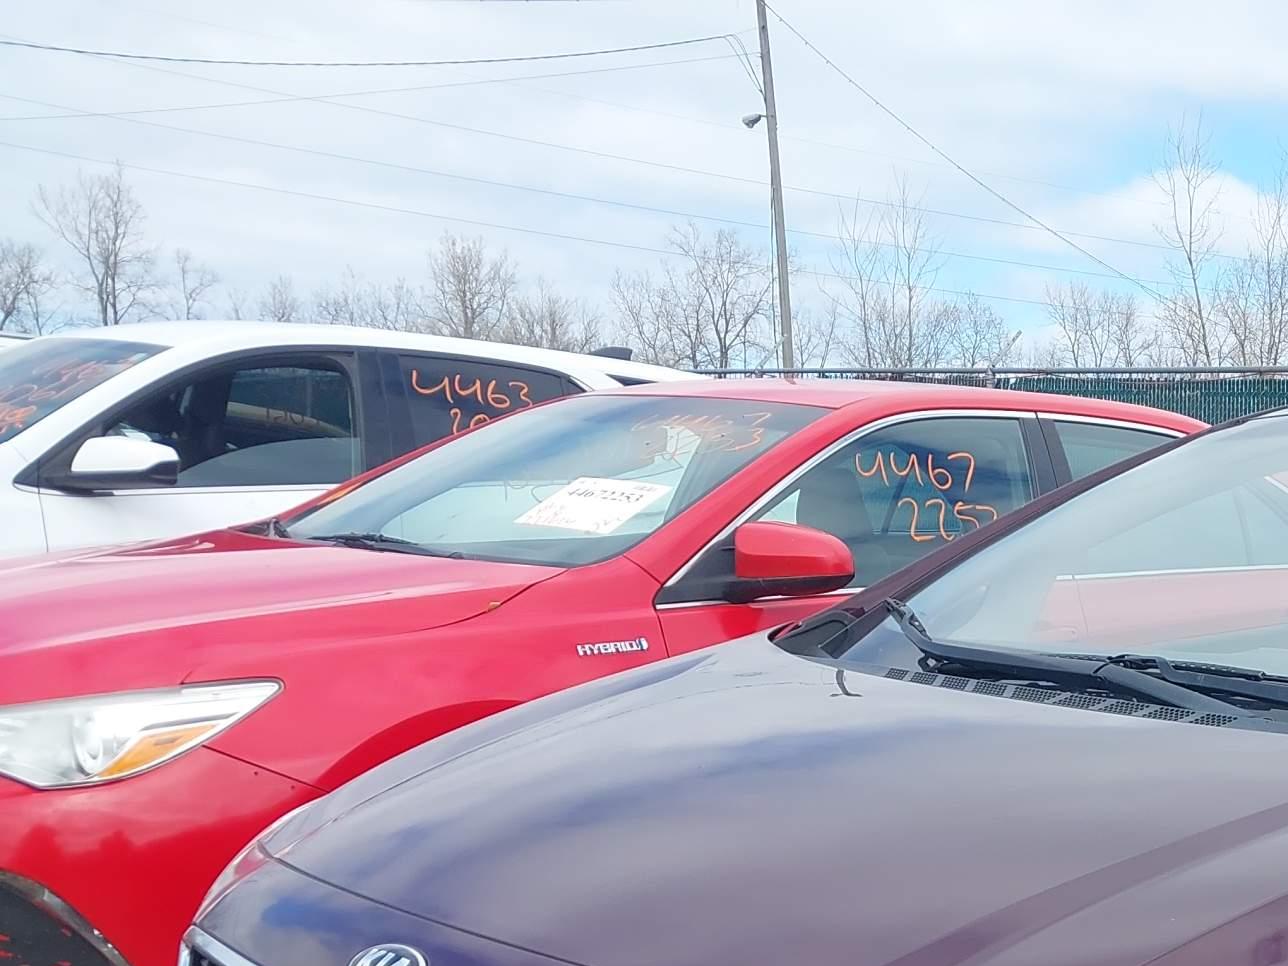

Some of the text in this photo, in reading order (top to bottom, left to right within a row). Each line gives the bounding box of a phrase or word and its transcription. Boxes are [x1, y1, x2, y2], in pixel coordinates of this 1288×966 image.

[411, 369, 533, 408] 4463
[855, 451, 975, 493] 4467
[576, 640, 641, 656] HYBRID
